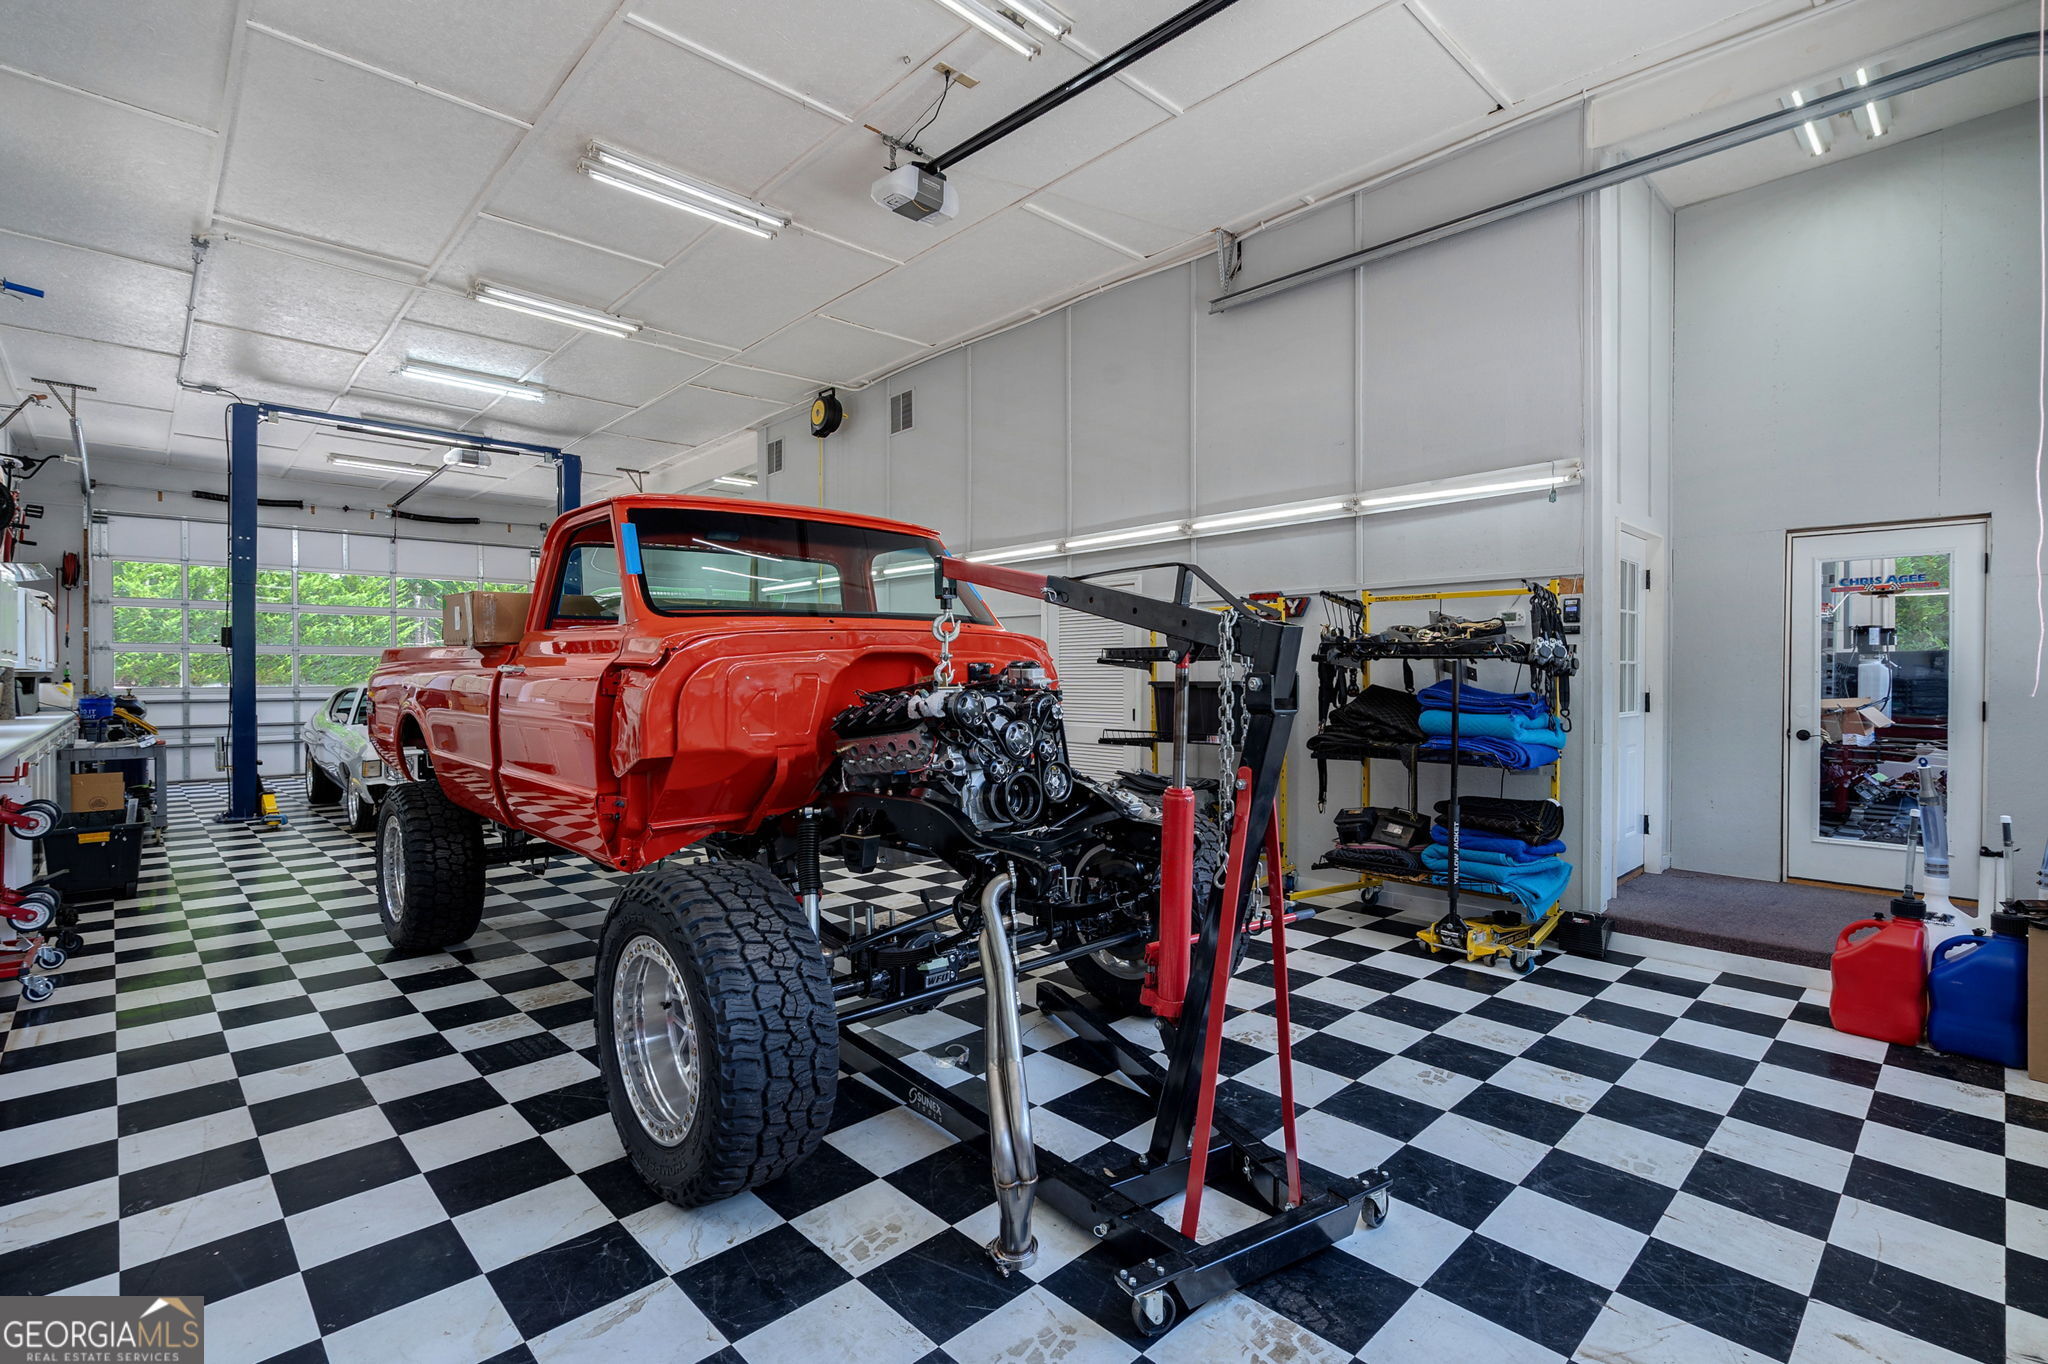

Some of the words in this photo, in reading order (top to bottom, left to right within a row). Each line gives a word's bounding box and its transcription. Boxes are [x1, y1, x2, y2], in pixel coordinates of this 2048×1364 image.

[1839, 577, 1882, 587] CHRIS
[1885, 573, 1927, 585] AGEE
[917, 1092, 942, 1117] SUNEX
